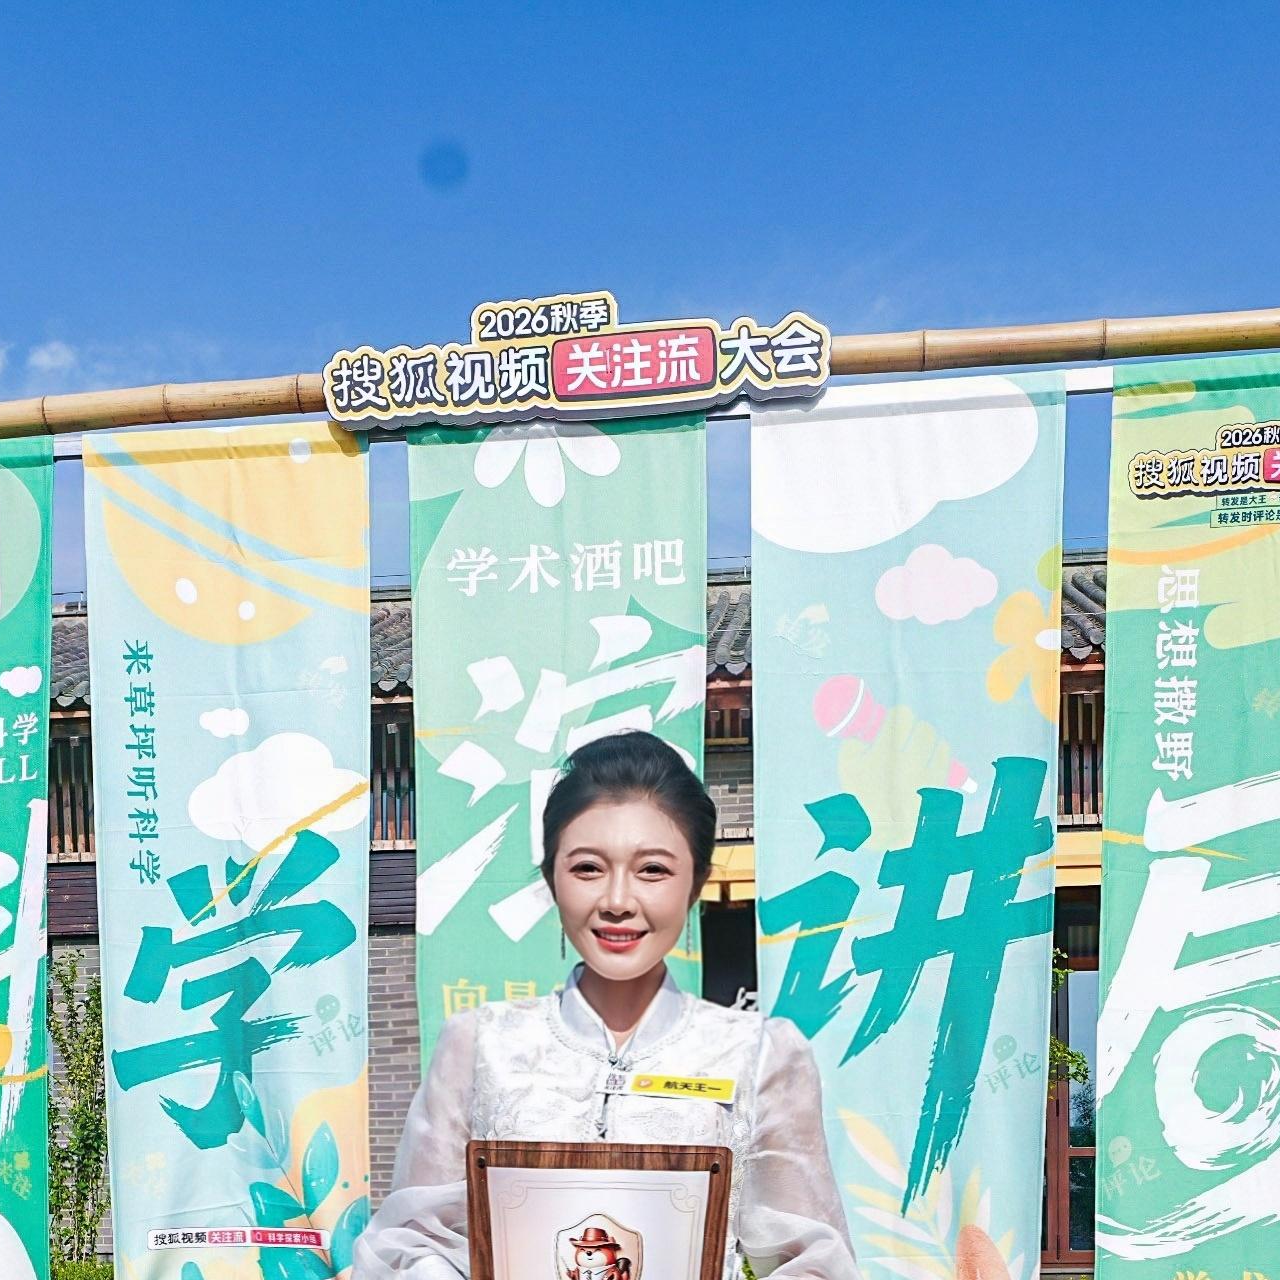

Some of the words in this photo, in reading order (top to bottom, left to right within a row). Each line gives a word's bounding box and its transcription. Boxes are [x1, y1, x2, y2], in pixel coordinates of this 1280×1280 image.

[480, 298, 609, 340] 2026秋季
[332, 319, 821, 407] 搜狐视频关注流大会
[1221, 494, 1267, 507] 转发是大王
[446, 538, 687, 597] 学术酒吧
[1151, 564, 1200, 782] 思想撒野
[122, 639, 161, 885] 来草坪听科学
[111, 828, 357, 1150] 学
[757, 756, 1055, 1219] 讲
[308, 1014, 365, 1057] 评论
[663, 1080, 721, 1093] 航天王一
[984, 1052, 1041, 1094] 评论
[1102, 1156, 1162, 1200] 评论
[153, 1231, 244, 1246] 搜狐视频关注流
